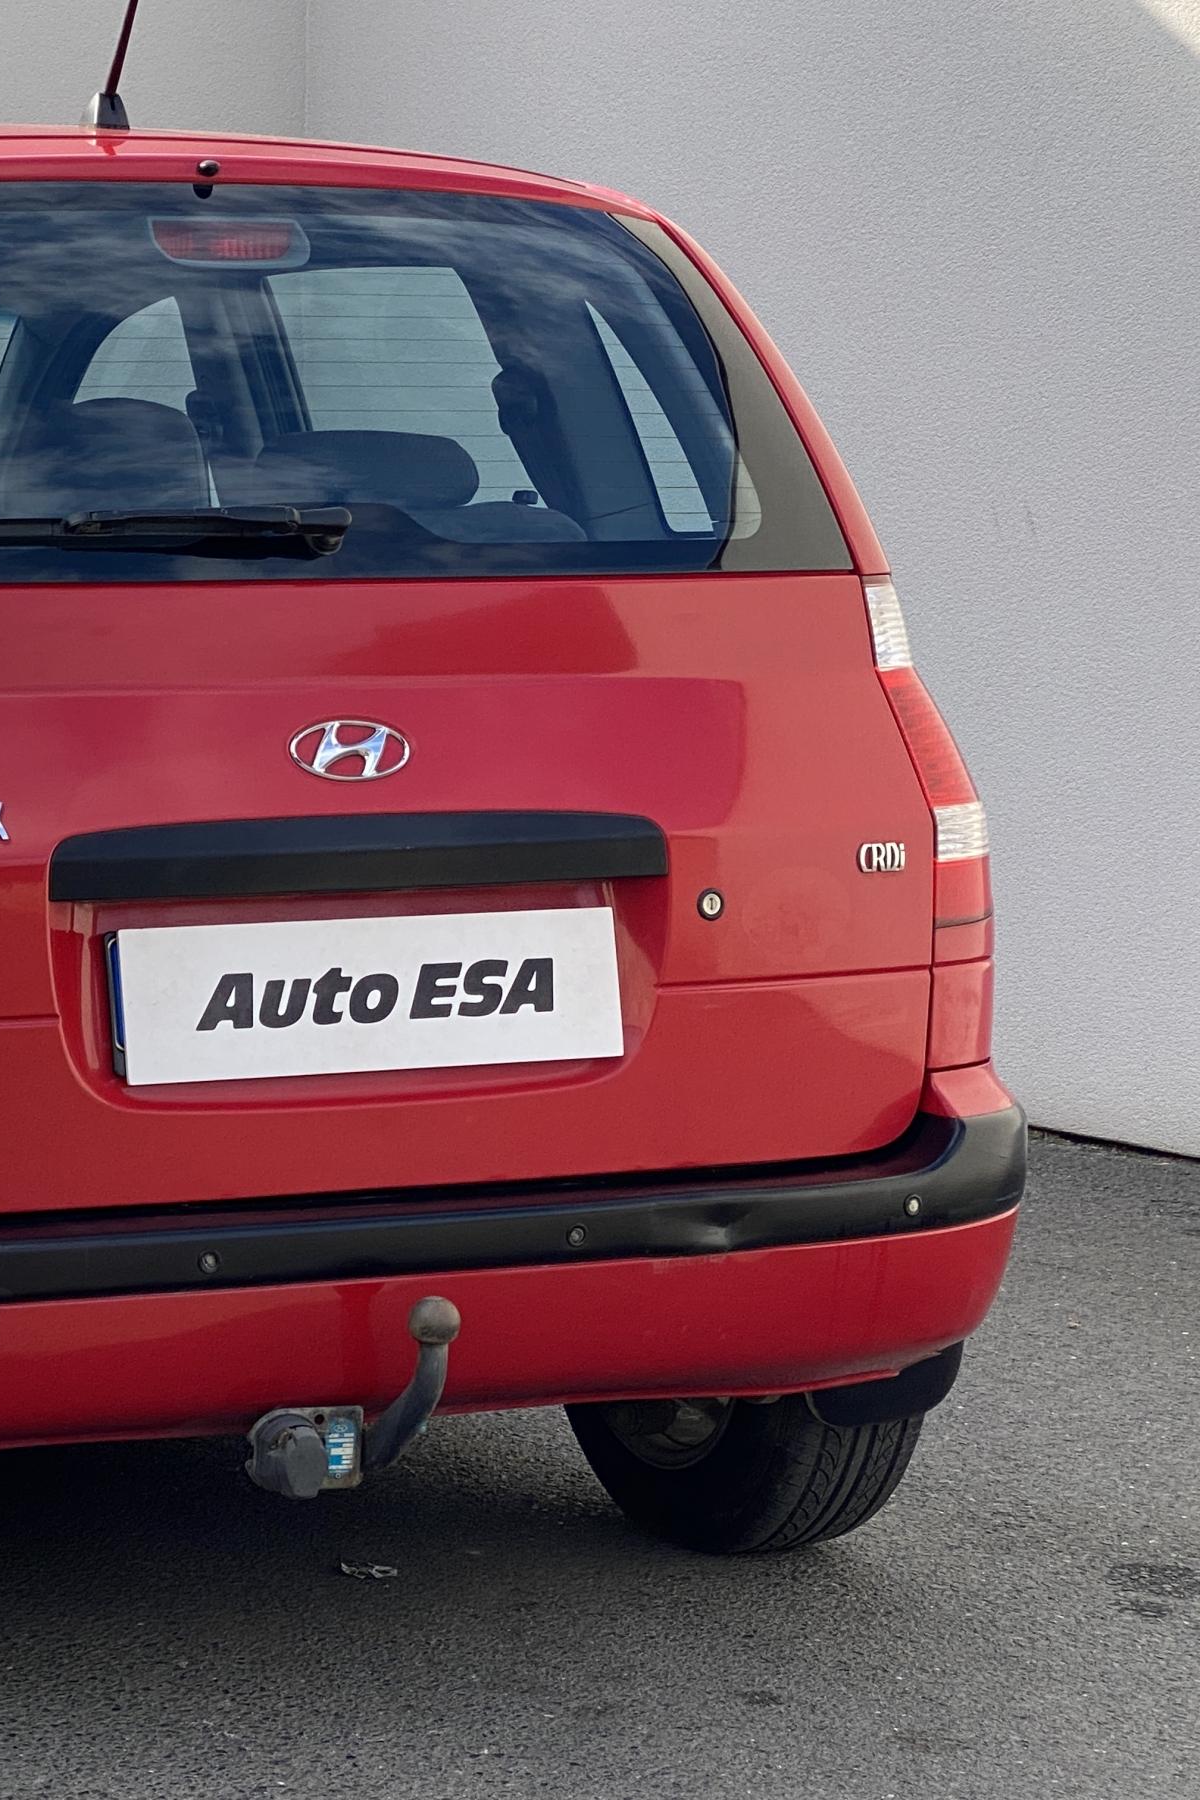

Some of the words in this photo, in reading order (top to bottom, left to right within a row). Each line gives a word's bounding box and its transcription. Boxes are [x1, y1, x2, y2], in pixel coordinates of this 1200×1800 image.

[858, 842, 906, 873] CRDi
[195, 966, 399, 1032] Auto
[409, 957, 554, 1020] ESA
